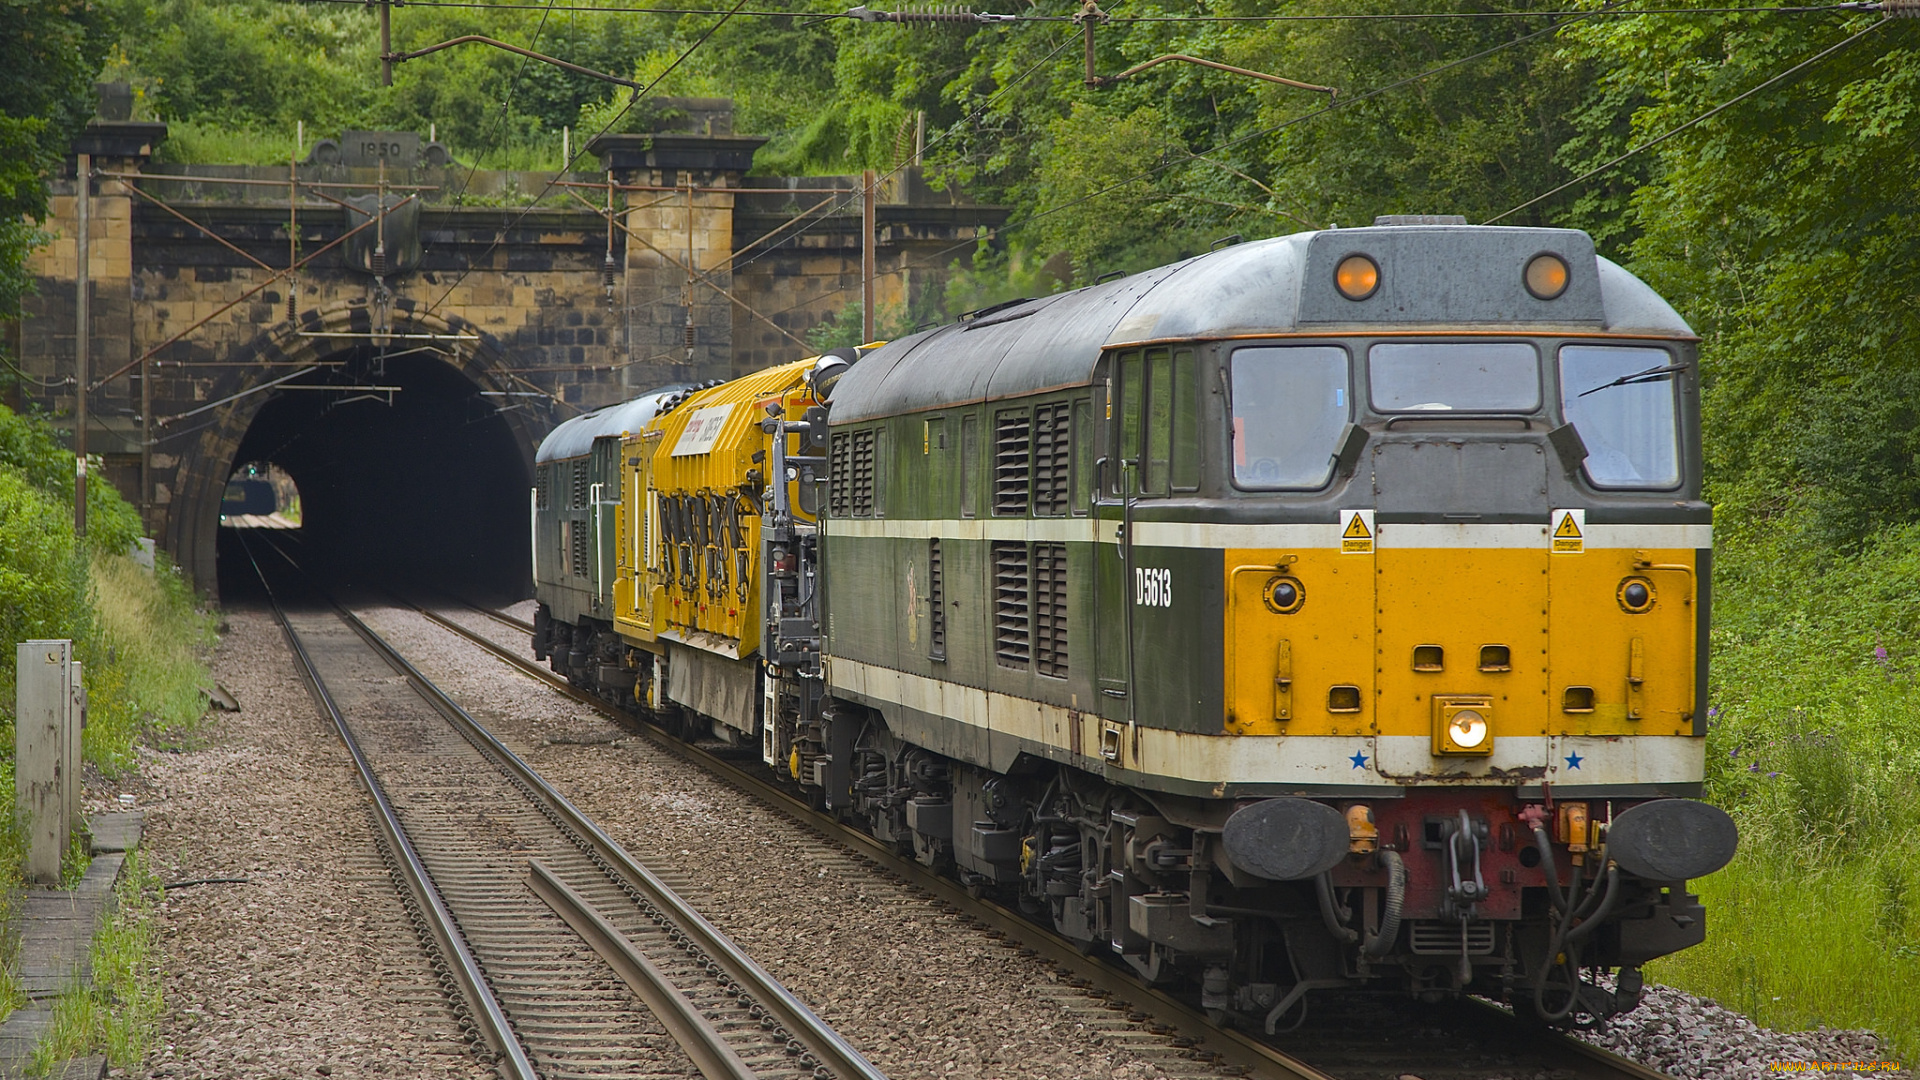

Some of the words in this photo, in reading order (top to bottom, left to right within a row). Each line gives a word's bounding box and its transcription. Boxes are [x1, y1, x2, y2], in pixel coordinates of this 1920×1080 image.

[361, 142, 400, 157] 1850
[1343, 540, 1371, 549] Danger
[1555, 539, 1582, 548] Danger
[1135, 567, 1172, 608] D5613
